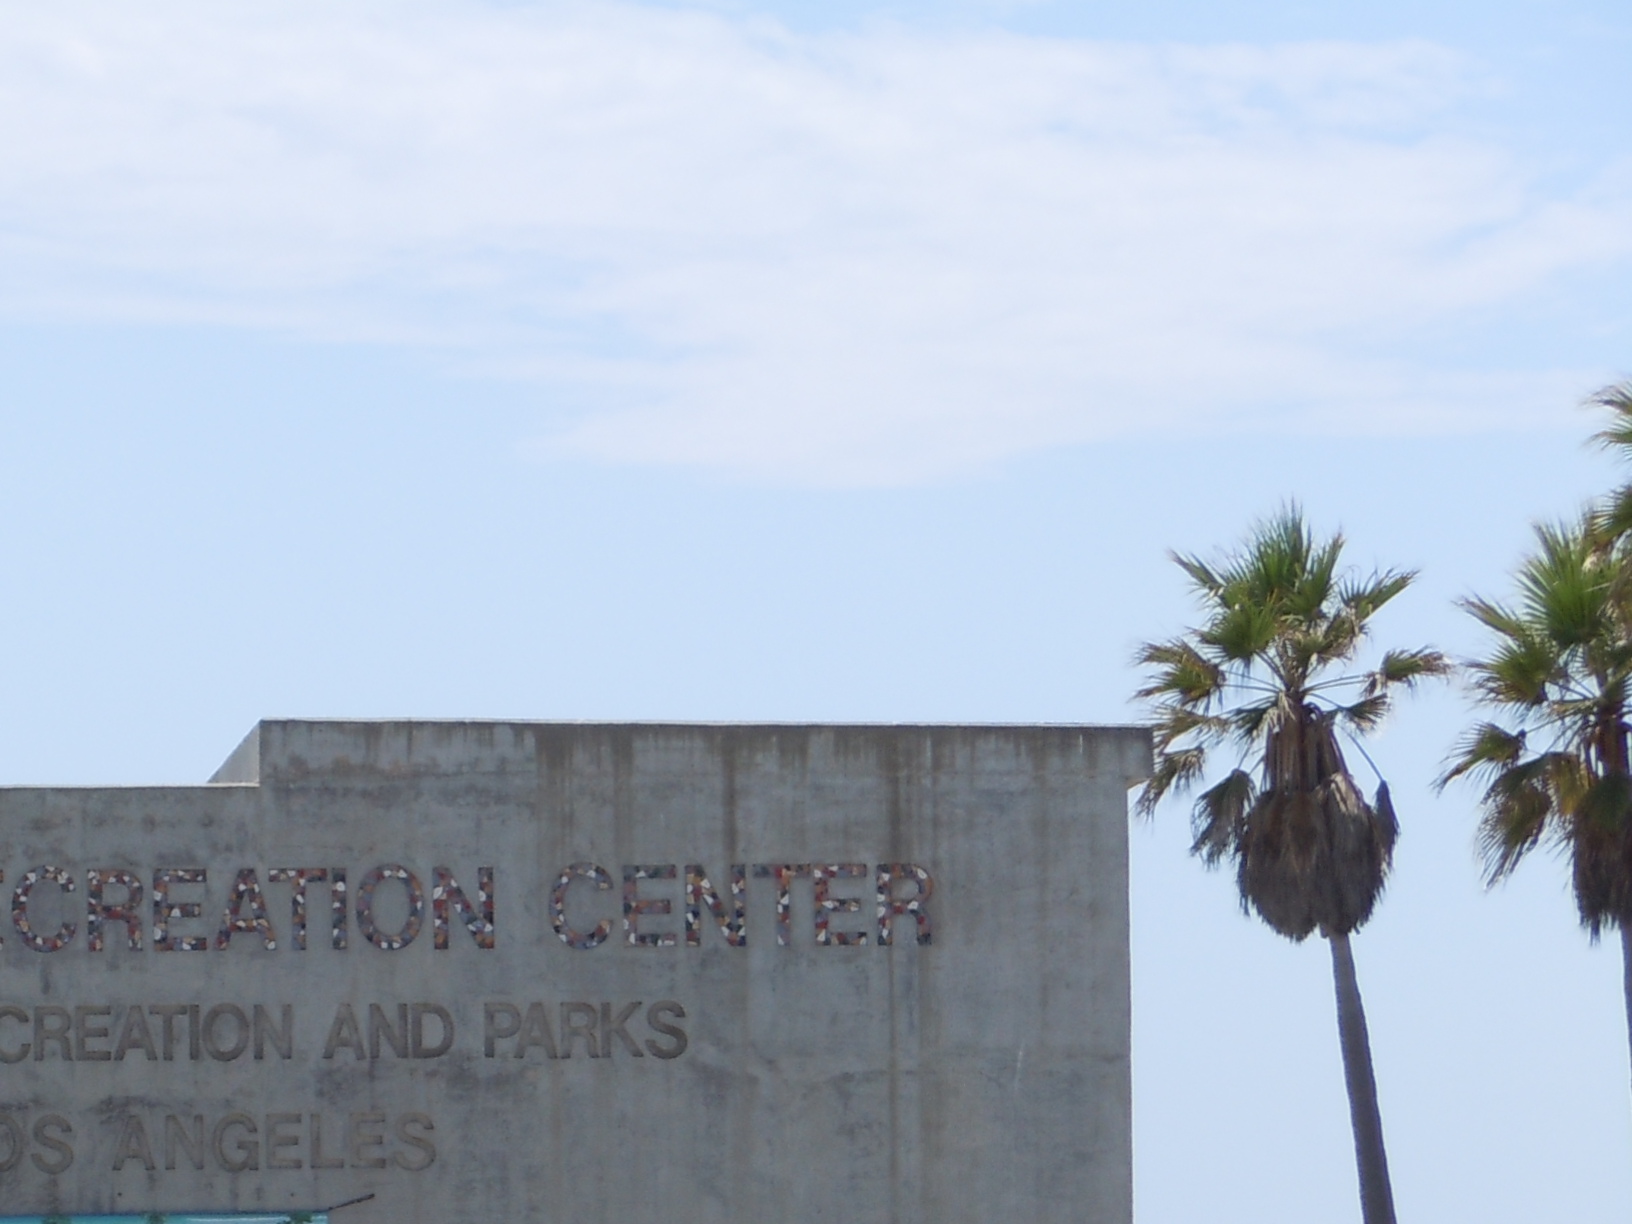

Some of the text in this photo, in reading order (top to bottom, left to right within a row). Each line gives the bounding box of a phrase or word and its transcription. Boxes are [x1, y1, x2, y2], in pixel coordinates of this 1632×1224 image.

[549, 862, 934, 949] CENTER
[323, 1002, 455, 1060] AND
[483, 1001, 688, 1060] PARKS
[112, 1113, 436, 1171] ANGELES
